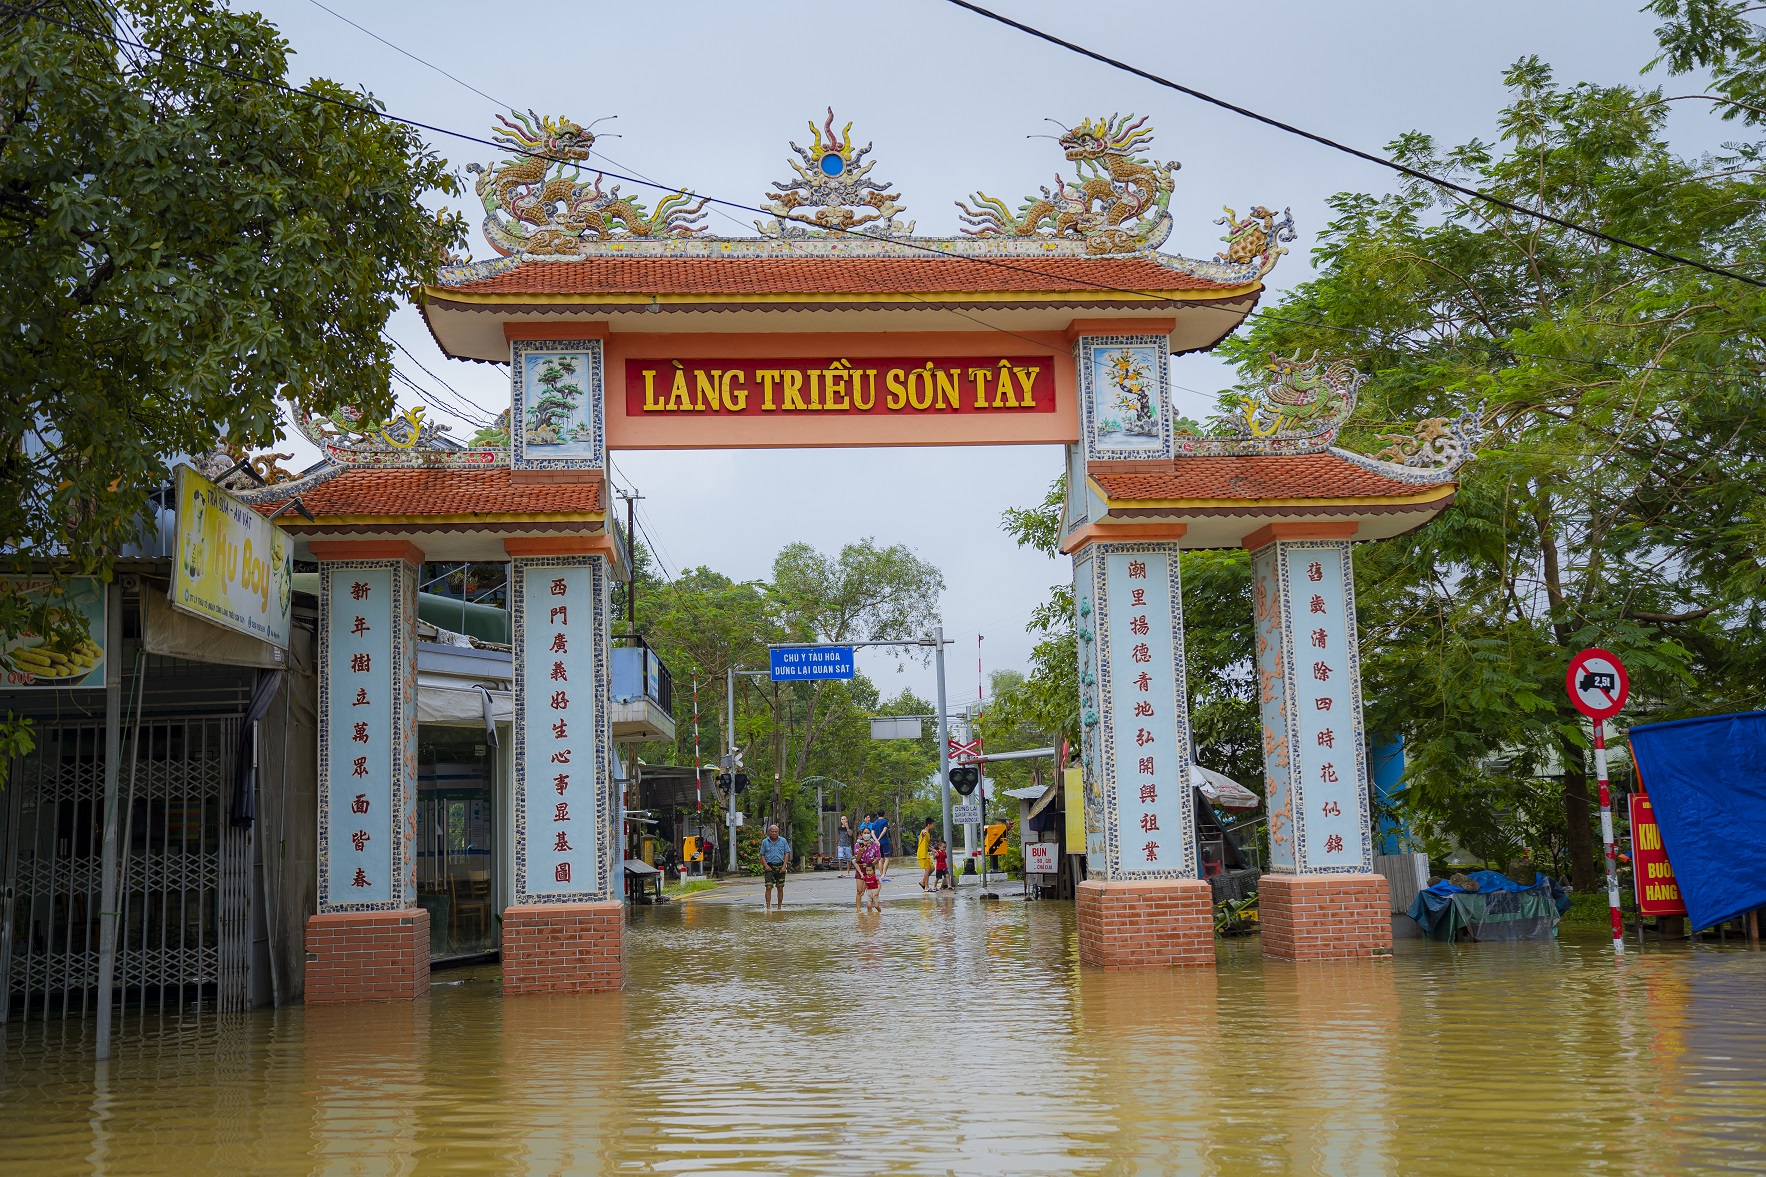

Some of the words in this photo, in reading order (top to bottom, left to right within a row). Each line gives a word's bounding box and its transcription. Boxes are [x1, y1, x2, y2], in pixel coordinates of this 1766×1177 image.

[642, 359, 748, 411] LÀNG
[756, 358, 876, 410] TRIỀU
[886, 361, 961, 410] SƠN
[968, 359, 1040, 408] TÂY
[242, 538, 270, 614] Boy
[7, 672, 35, 684] QUE
[797, 666, 811, 676] LẠI
[812, 665, 834, 674] QUAN
[1638, 823, 1661, 851] KHU
[1032, 844, 1047, 857] BÚN
[1645, 882, 1678, 901] HÀNG
